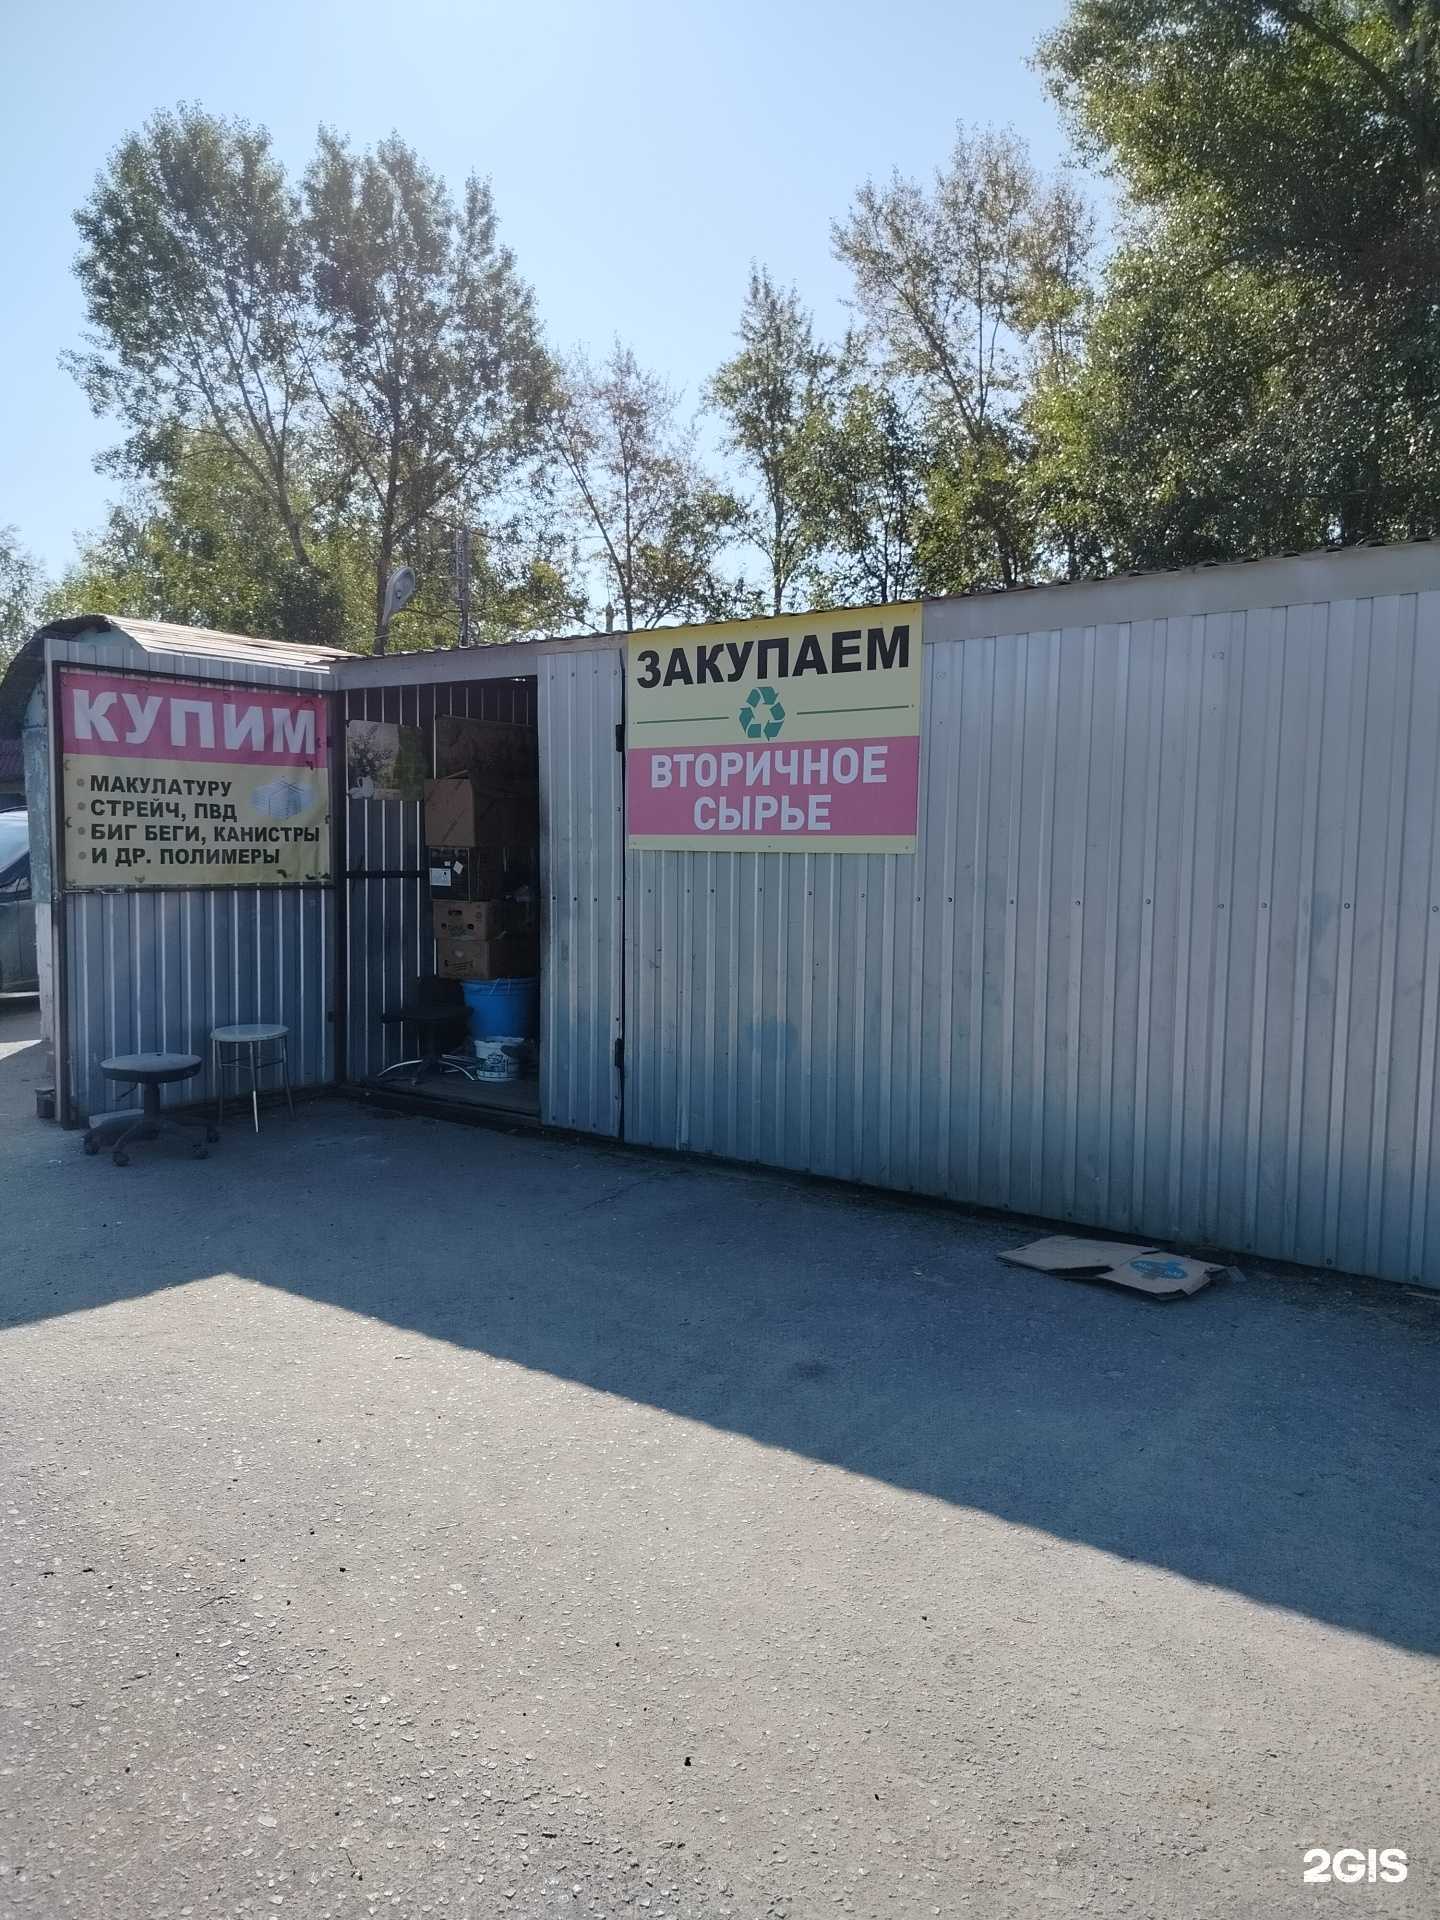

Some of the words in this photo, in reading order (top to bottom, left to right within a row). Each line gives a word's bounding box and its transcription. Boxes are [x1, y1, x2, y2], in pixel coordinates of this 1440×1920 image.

[637, 625, 909, 688] ЗАКУПАЕМ
[72, 688, 315, 755] КУПИМ
[651, 745, 888, 788] ВТОРИЧНОЕ
[90, 775, 232, 797] МАКУЛАТУРУ
[90, 799, 186, 821] СТРЕЙЧ,
[194, 804, 237, 822] ПВД
[694, 795, 832, 831] СЫРЬЕ
[91, 824, 137, 841] БИГ
[145, 824, 206, 845] БЕГИ,
[214, 827, 320, 843] КАНИСТРЫ
[91, 848, 108, 864] И
[115, 848, 151, 867] ДР.
[160, 848, 280, 865] ПОЛИМЕРЫ
